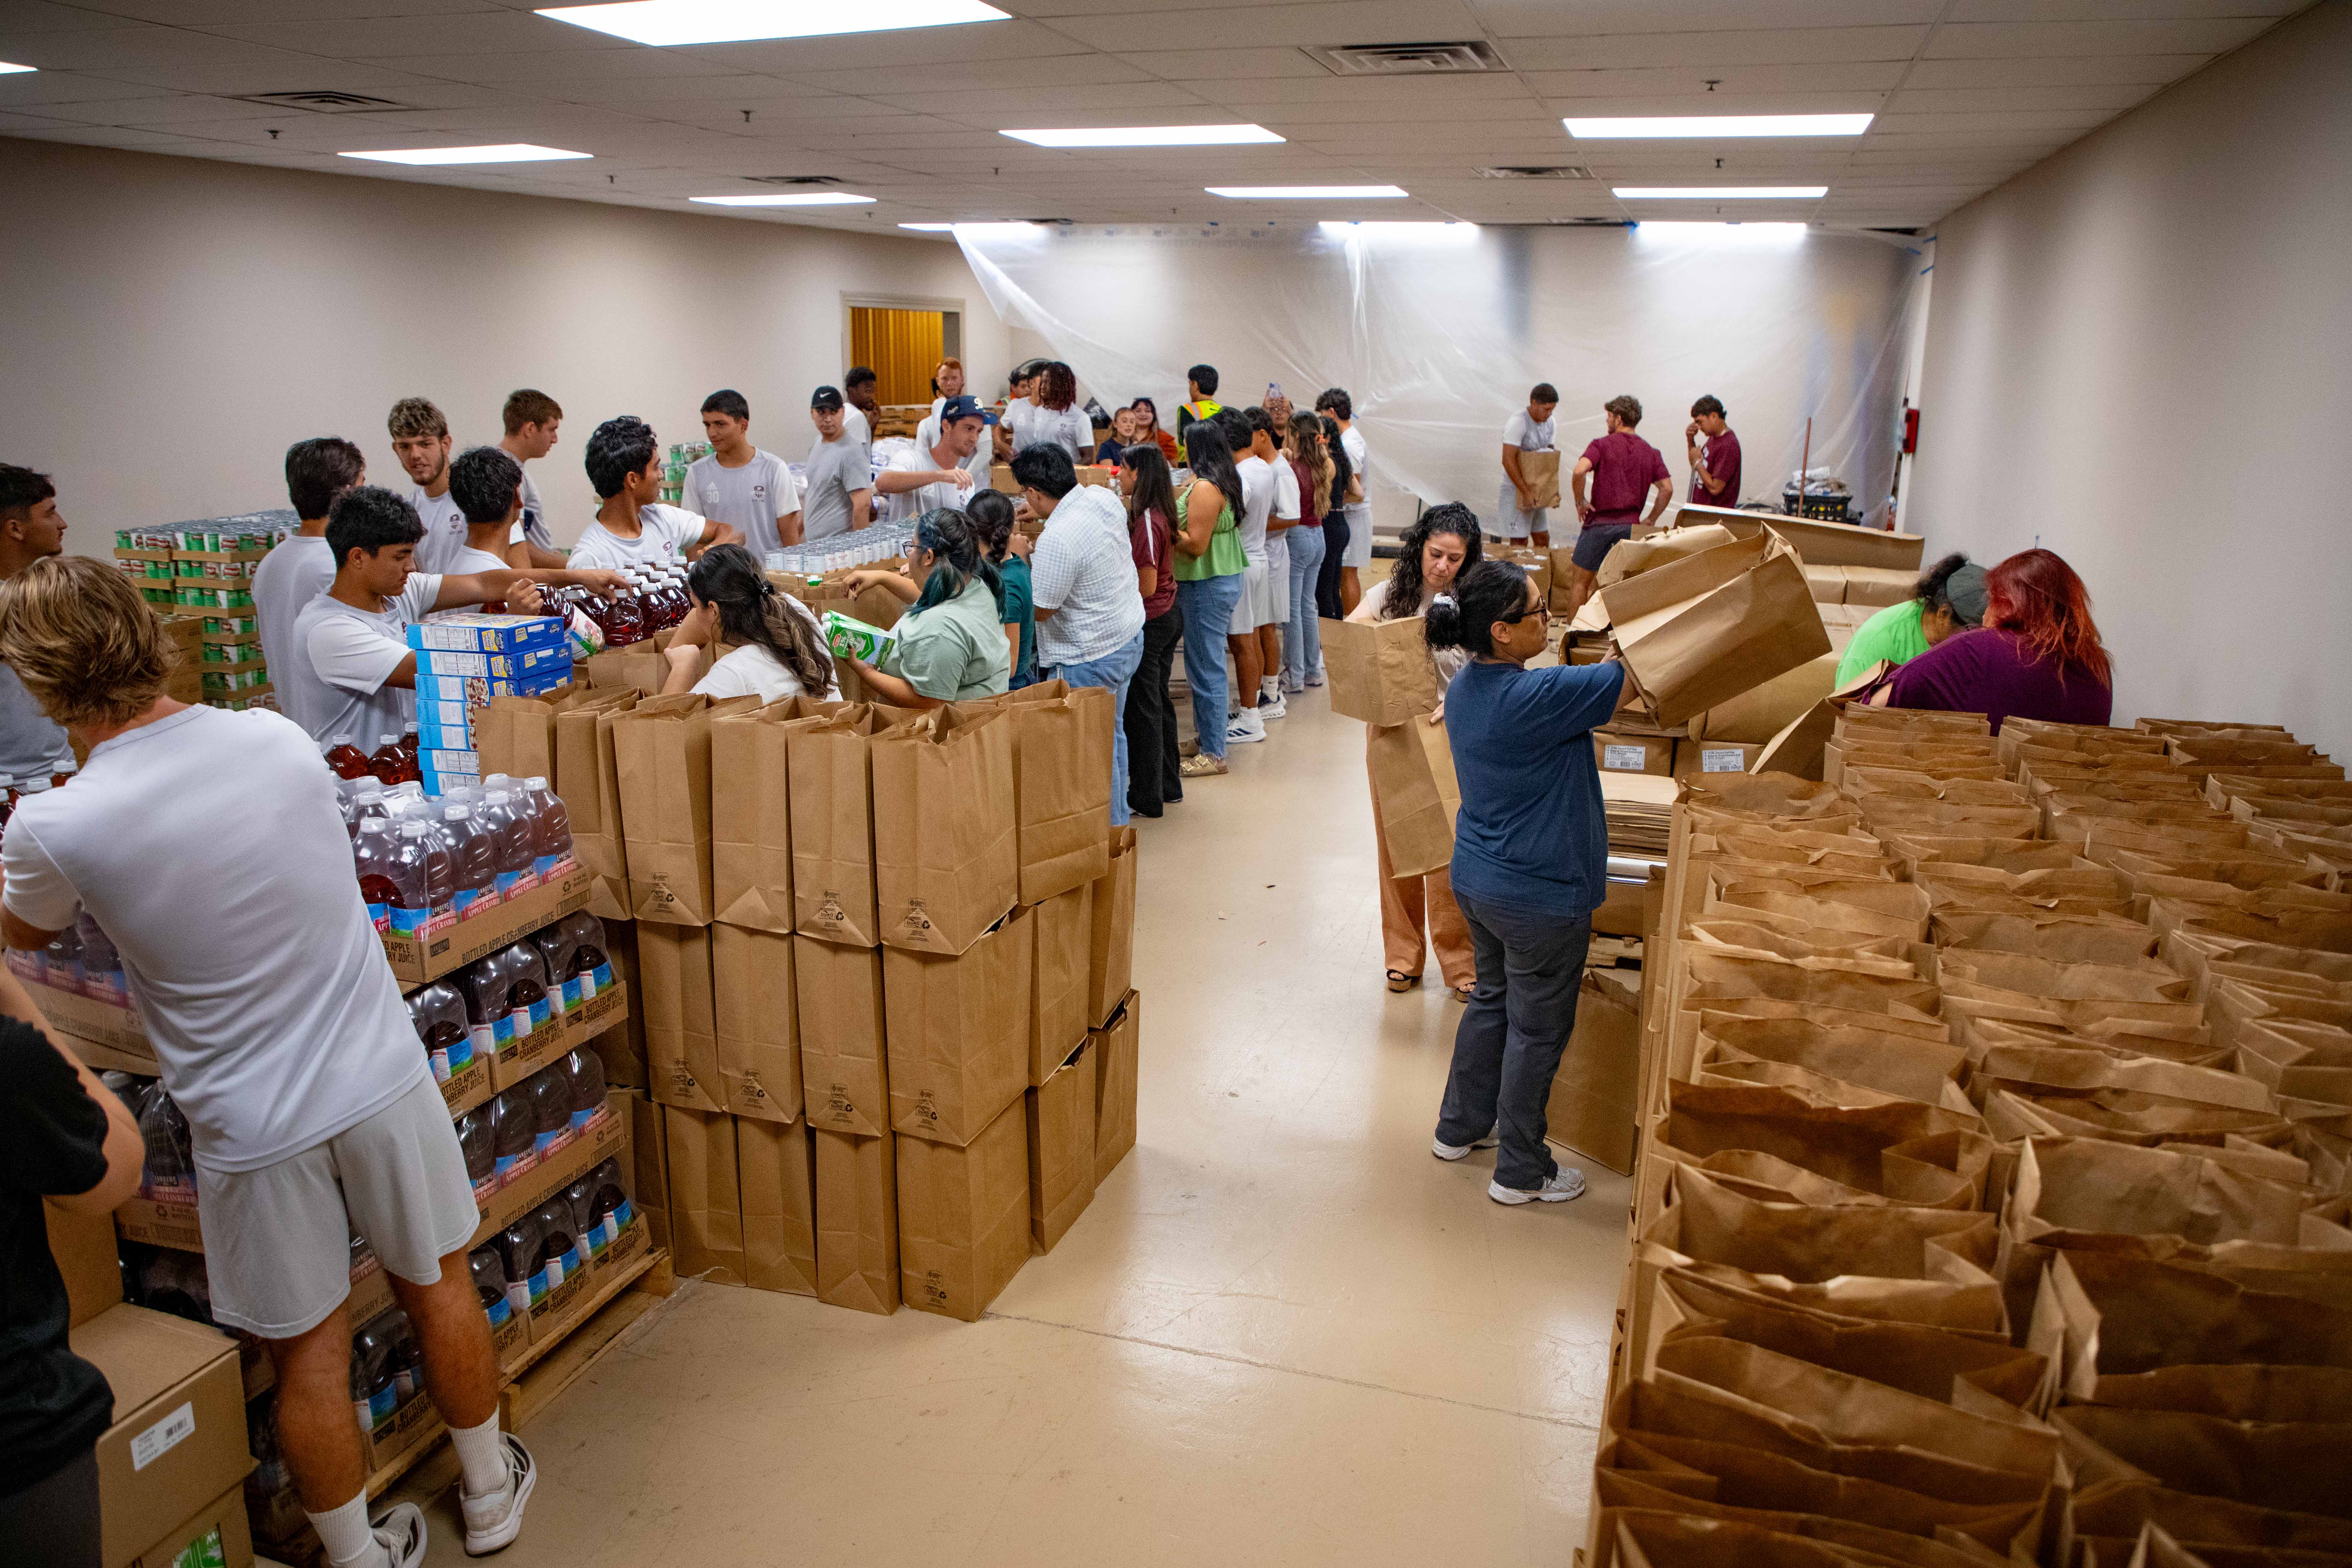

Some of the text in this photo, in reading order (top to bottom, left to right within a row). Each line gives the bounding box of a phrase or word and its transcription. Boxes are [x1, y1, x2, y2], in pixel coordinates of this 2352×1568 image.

[707, 491, 719, 502] 30
[557, 849, 571, 861] LANGERS
[519, 865, 532, 878] LANGERS
[548, 868, 561, 881] APPLE
[478, 884, 494, 896] LANGERS
[510, 885, 523, 898] APPLE
[432, 903, 450, 915] LANGERS
[467, 906, 482, 919] APPLE
[377, 922, 389, 932] APP
[462, 911, 554, 964] BOTTLED APPLE CRANBERRY JUICE
[390, 943, 410, 953] APPLE
[398, 952, 416, 964] JUICE
[586, 989, 620, 1014] BOTTLED APPLE
[584, 1004, 611, 1024] CRANBERRY
[611, 996, 624, 1009] JUICE
[521, 1021, 559, 1048] BOTTLED APPLE
[520, 1038, 549, 1059] CRANBERRY
[550, 1029, 564, 1043] JUICE
[441, 1066, 480, 1096] OTTLED APPLE
[446, 1083, 468, 1104] NBERRY
[470, 1074, 485, 1090] JUICE
[556, 1122, 570, 1136] LANGERS
[584, 1120, 597, 1134] APPLE
[516, 1147, 533, 1161] LANGERS
[547, 1142, 561, 1156] APPLE
[476, 1172, 493, 1186] LANGERS
[505, 1169, 521, 1182] APPLE
[501, 1205, 525, 1228] BOTTLED
[526, 1194, 542, 1210] APPLE
[543, 1174, 574, 1199] CRANBERRY
[575, 1162, 589, 1179] JUICE
[612, 1234, 632, 1254] BOTTLED
[354, 1249, 374, 1265] LANGERS
[611, 1242, 635, 1263] CRANBERR
[552, 1268, 586, 1302] BOTTLED APPLE
[550, 1286, 577, 1313] CRANBERRY
[504, 1321, 519, 1340] APPLE
[400, 1394, 426, 1421] BOTTLED
[397, 1402, 432, 1433] CRANBERRY
